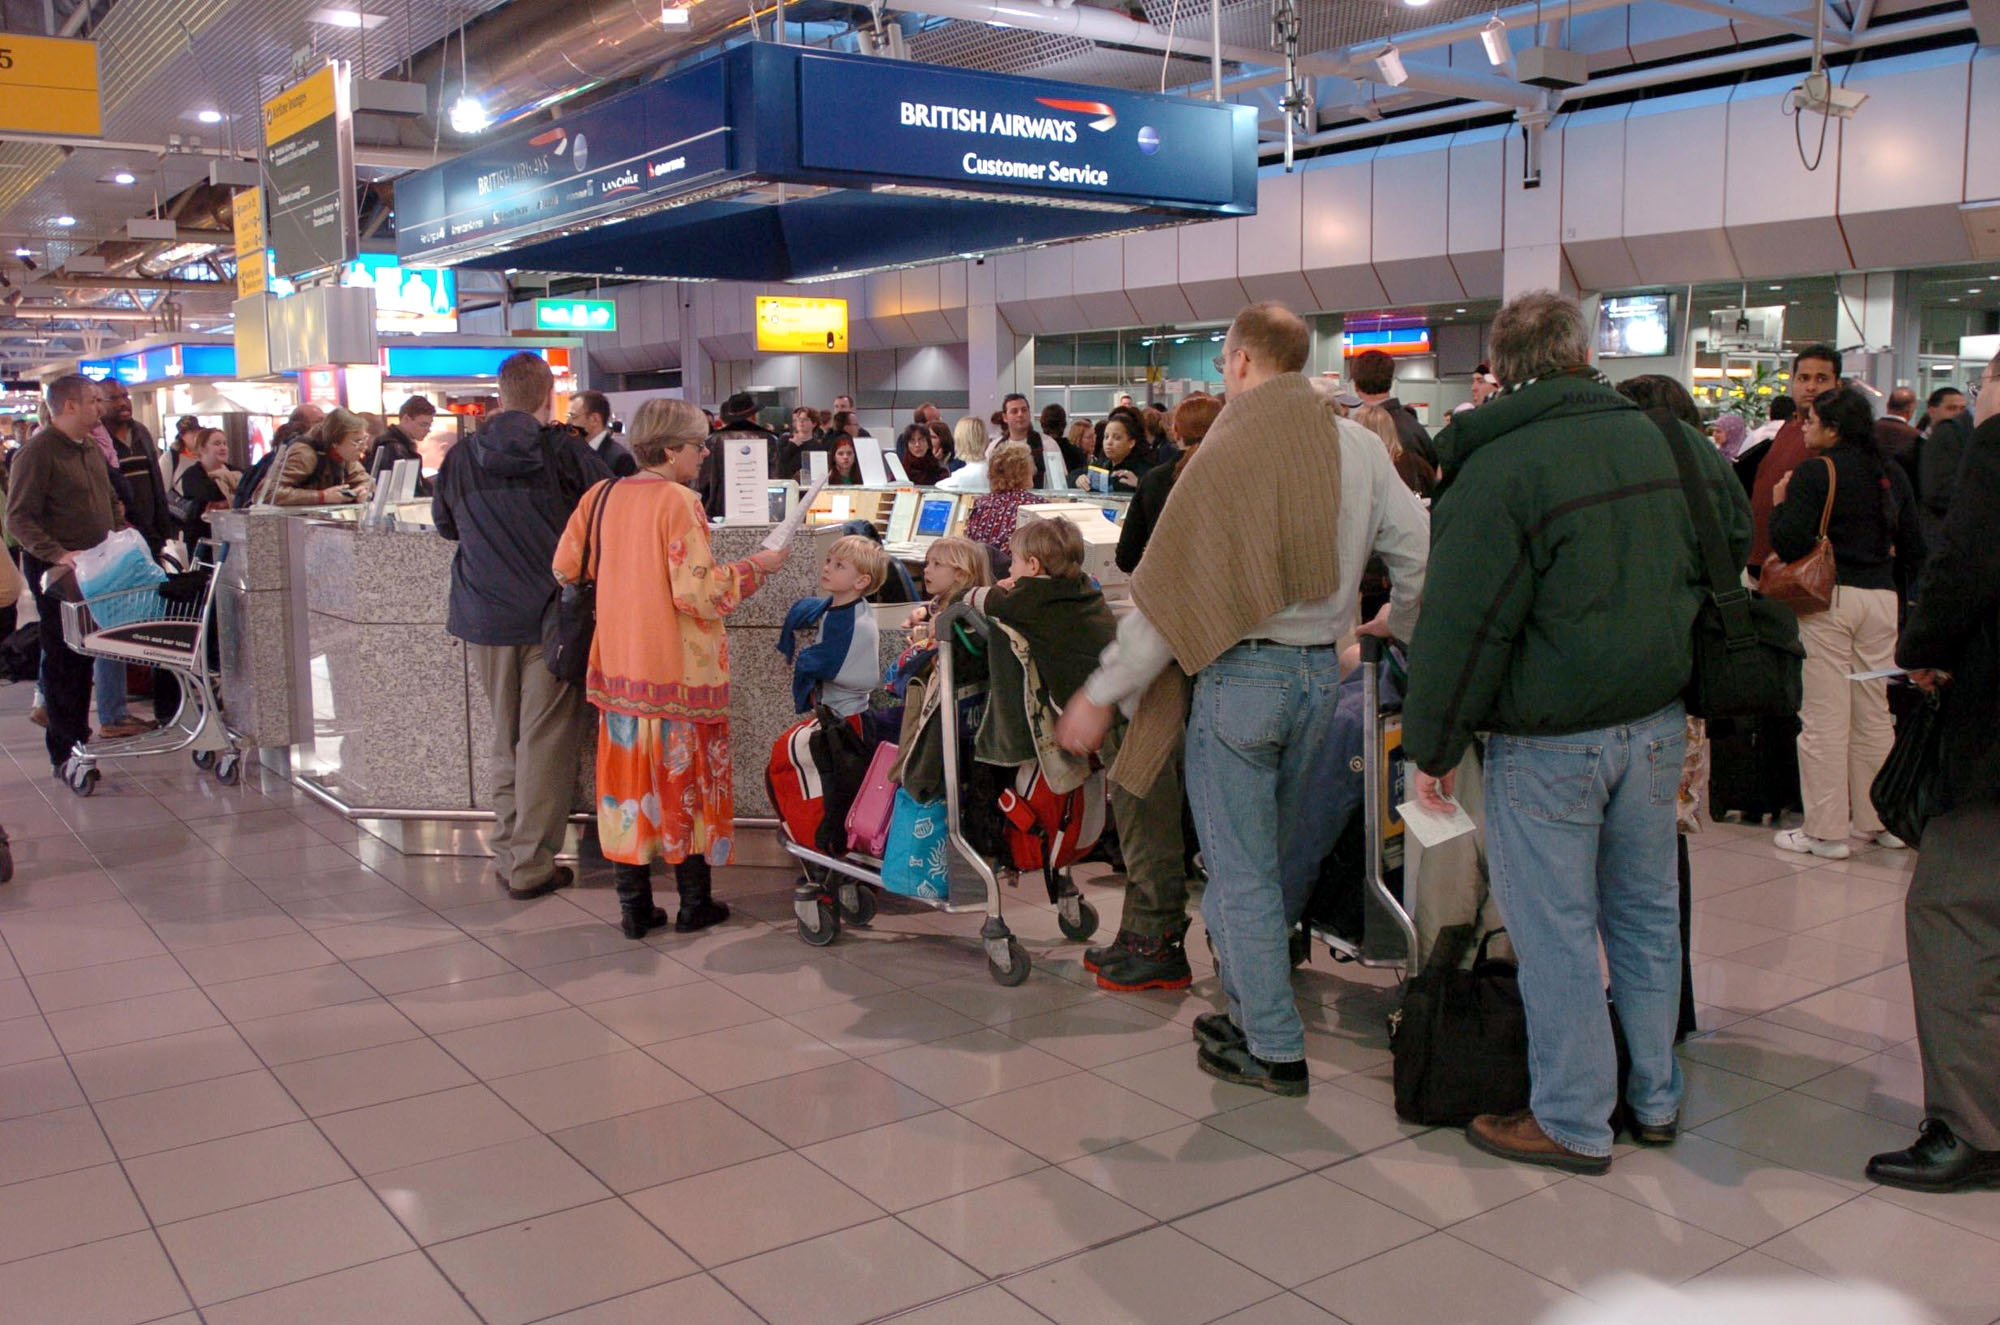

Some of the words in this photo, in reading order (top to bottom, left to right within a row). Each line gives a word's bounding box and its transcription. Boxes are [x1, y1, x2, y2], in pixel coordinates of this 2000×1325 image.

[900, 101, 987, 133] BRITISH
[990, 113, 1077, 143] AIRWAYS
[478, 167, 510, 196] BRITISH
[962, 152, 1046, 179] Customer
[1049, 160, 1108, 186] Service
